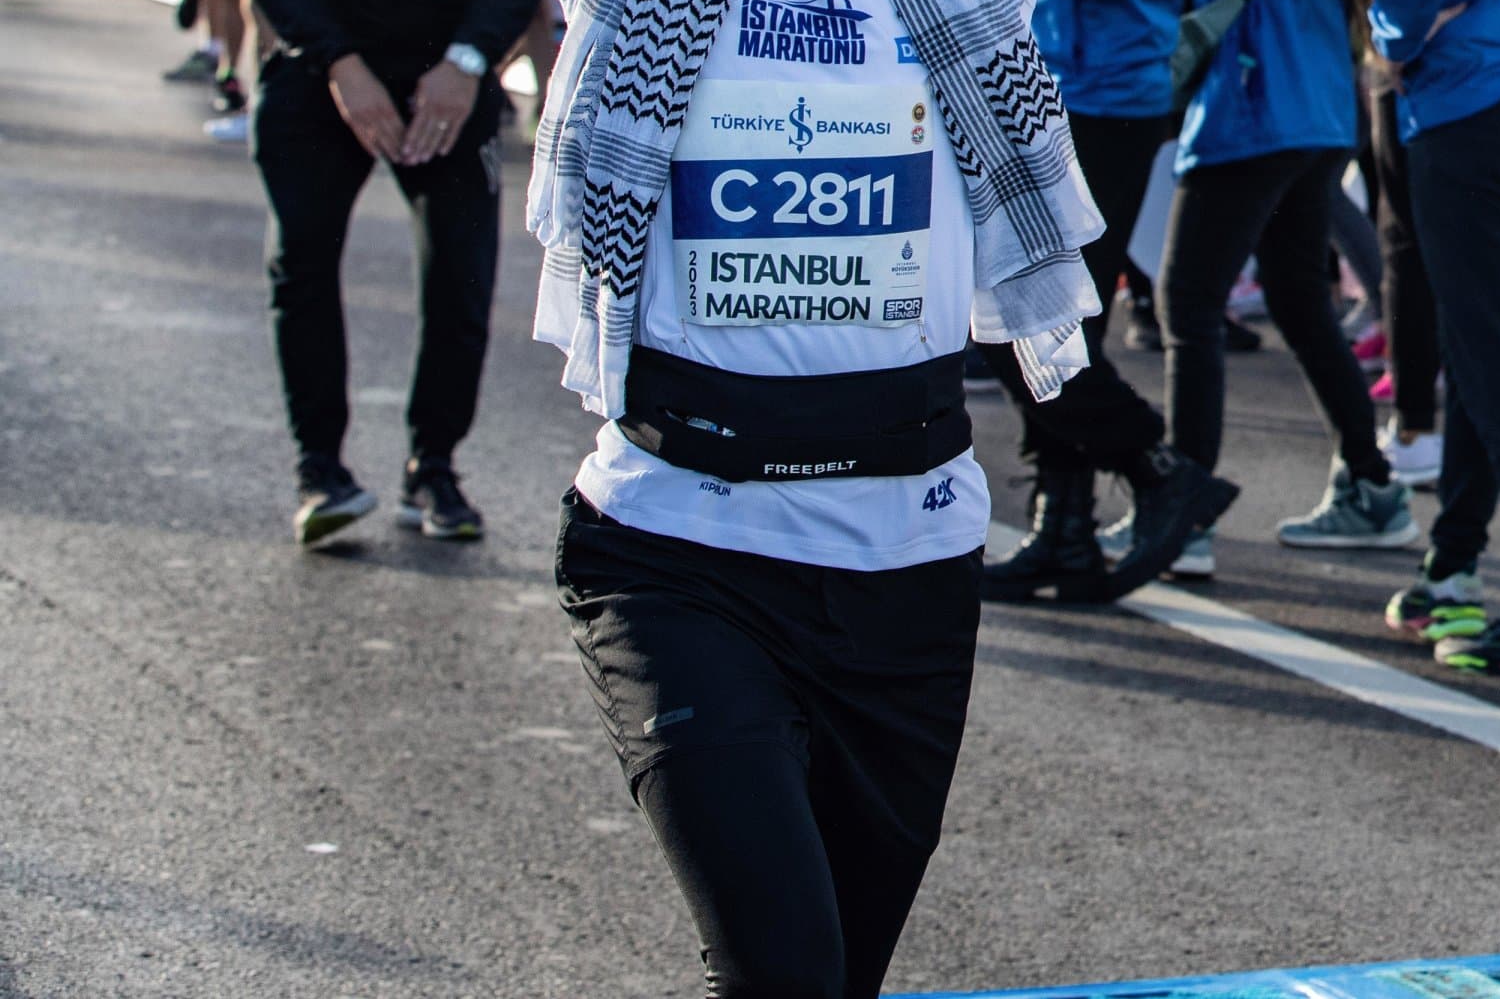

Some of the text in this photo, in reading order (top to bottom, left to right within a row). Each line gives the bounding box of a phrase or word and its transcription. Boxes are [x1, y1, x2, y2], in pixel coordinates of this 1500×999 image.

[738, 29, 866, 65] MARATONU
[711, 113, 785, 132] TÜRKİYE
[816, 120, 891, 136] BANKASI
[710, 168, 895, 226] C 2811
[710, 251, 871, 286] ISTANBUL
[705, 292, 871, 321] MARATHON
[886, 300, 920, 312] SPOR
[763, 460, 857, 475] FREEBELT
[921, 477, 957, 512] 42K
